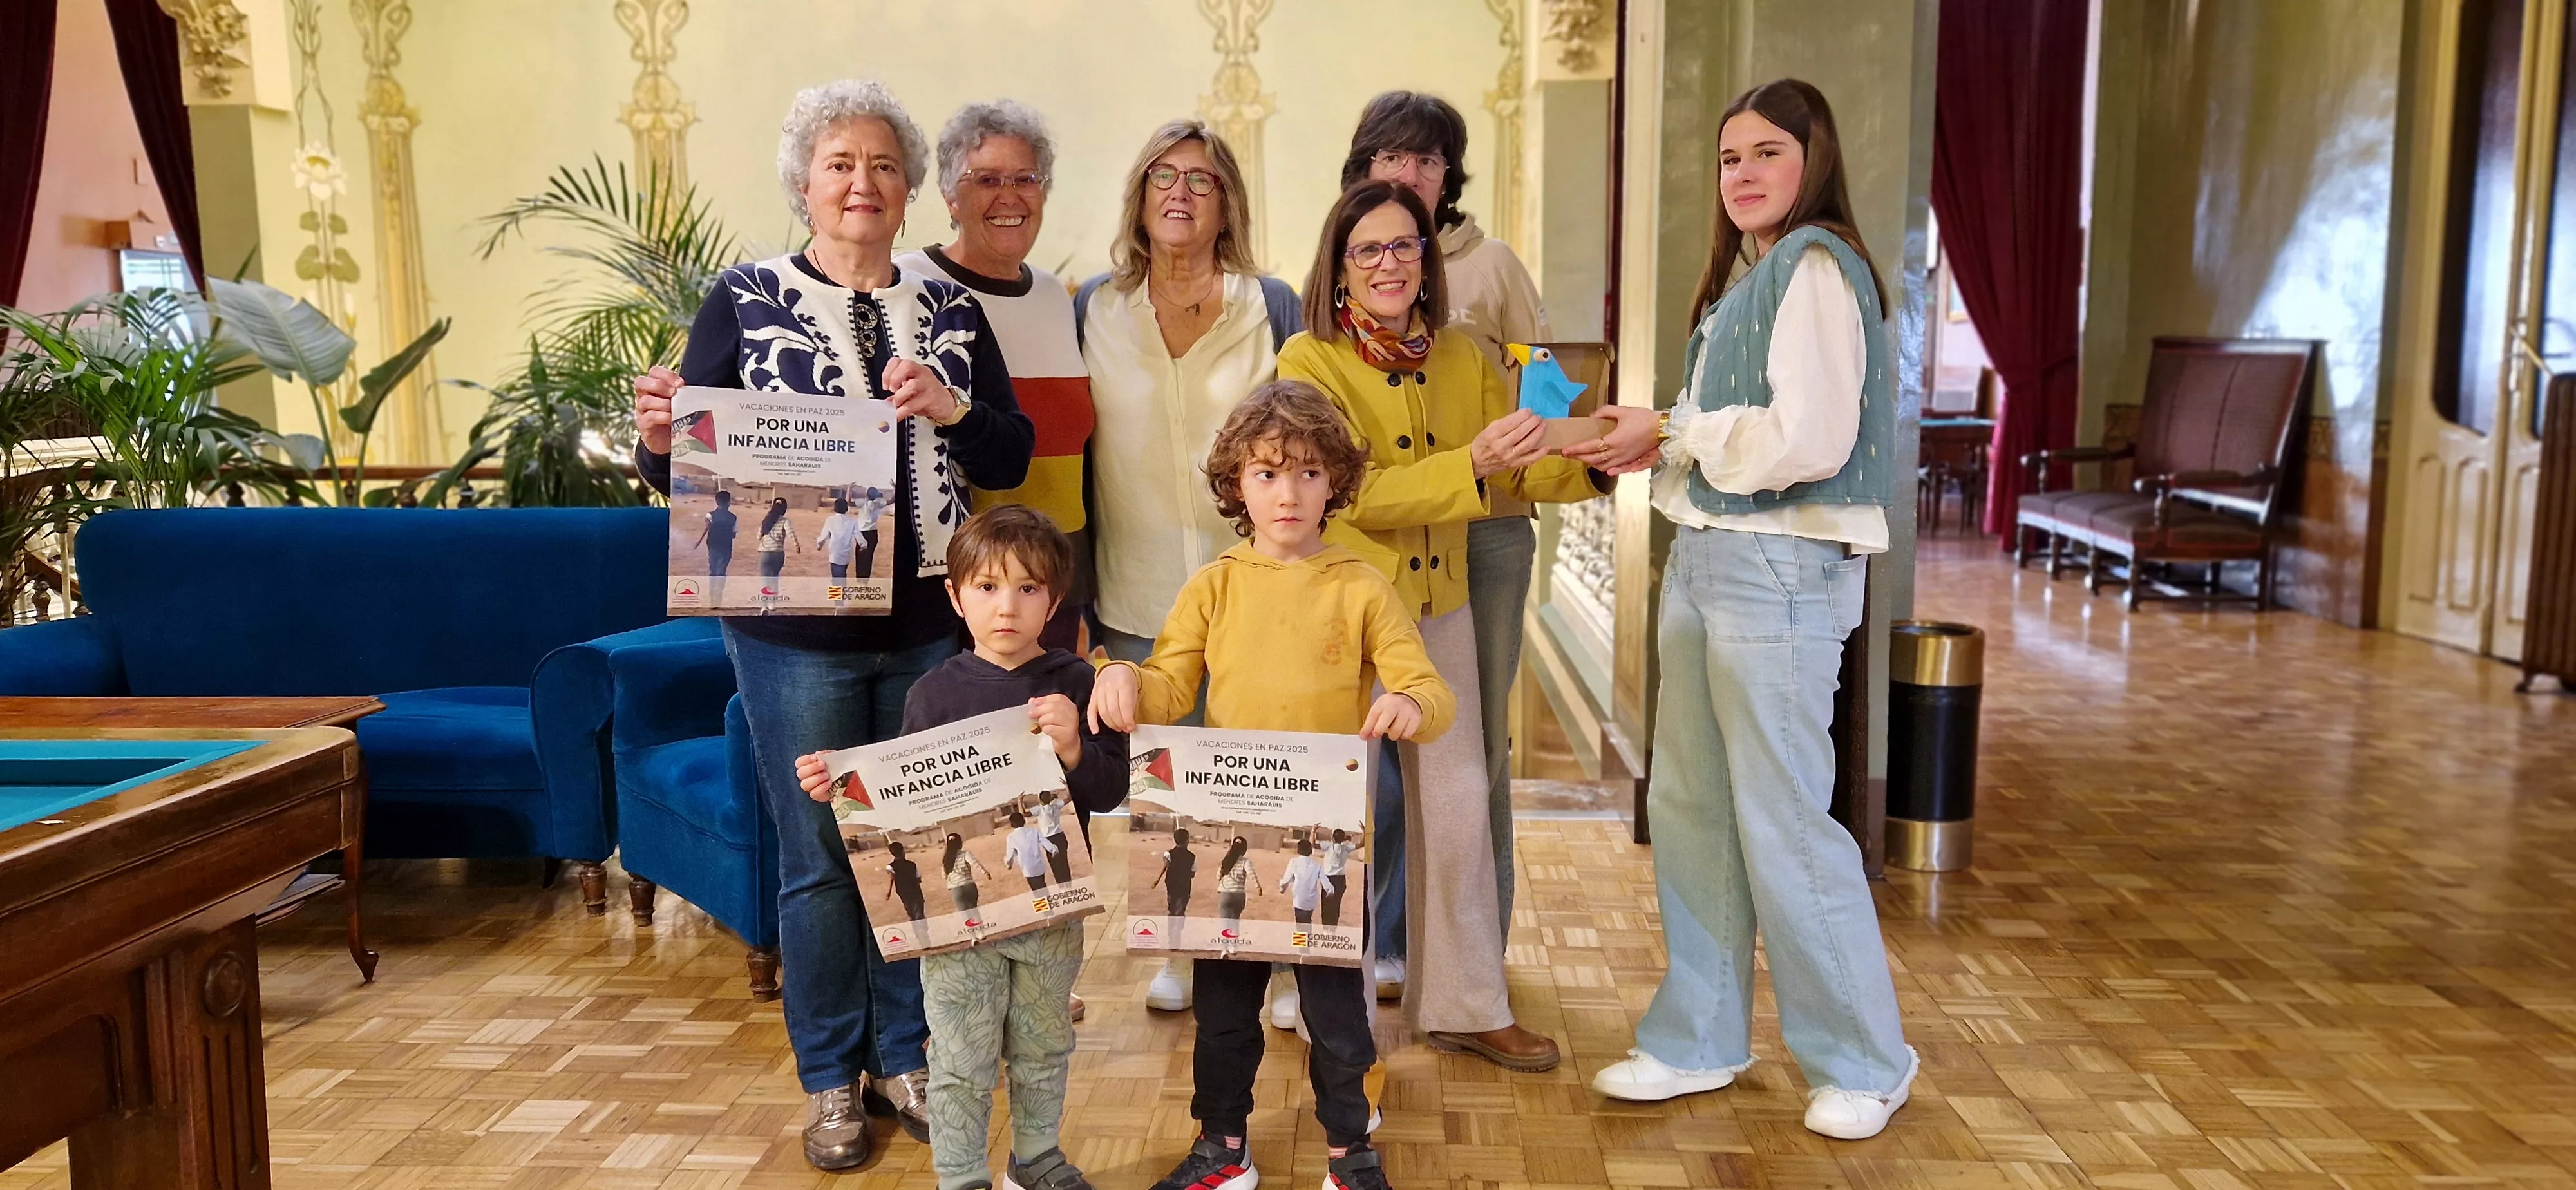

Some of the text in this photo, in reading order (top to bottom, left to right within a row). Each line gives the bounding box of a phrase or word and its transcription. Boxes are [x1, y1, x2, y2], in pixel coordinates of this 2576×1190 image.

[739, 402, 793, 413] VACACIONES
[808, 407, 823, 415] PAZ
[756, 417, 829, 434] POR UNA
[728, 433, 855, 453] INFANCIA LIBRE
[750, 593, 790, 601] alouda
[878, 726, 991, 763] VACACIONES EN PAZ 2025
[1196, 739, 1309, 753] VACACIONES EN PAZ 2025
[900, 745, 980, 778] POR UNA
[1213, 755, 1291, 772] POR UNA
[878, 753, 1013, 801] INFANCIA LIBRE
[1185, 771, 1320, 793] INFANCIA LIBRE
[908, 793, 944, 806] PROGRAMA
[954, 781, 983, 793] ACOGIDA
[947, 788, 983, 802] SAHARAUIS
[1047, 886, 1088, 902] GOBIERNO
[1049, 900, 1060, 909] DE
[957, 921, 997, 936] alouda
[1307, 933, 1350, 943] GOBIERNO
